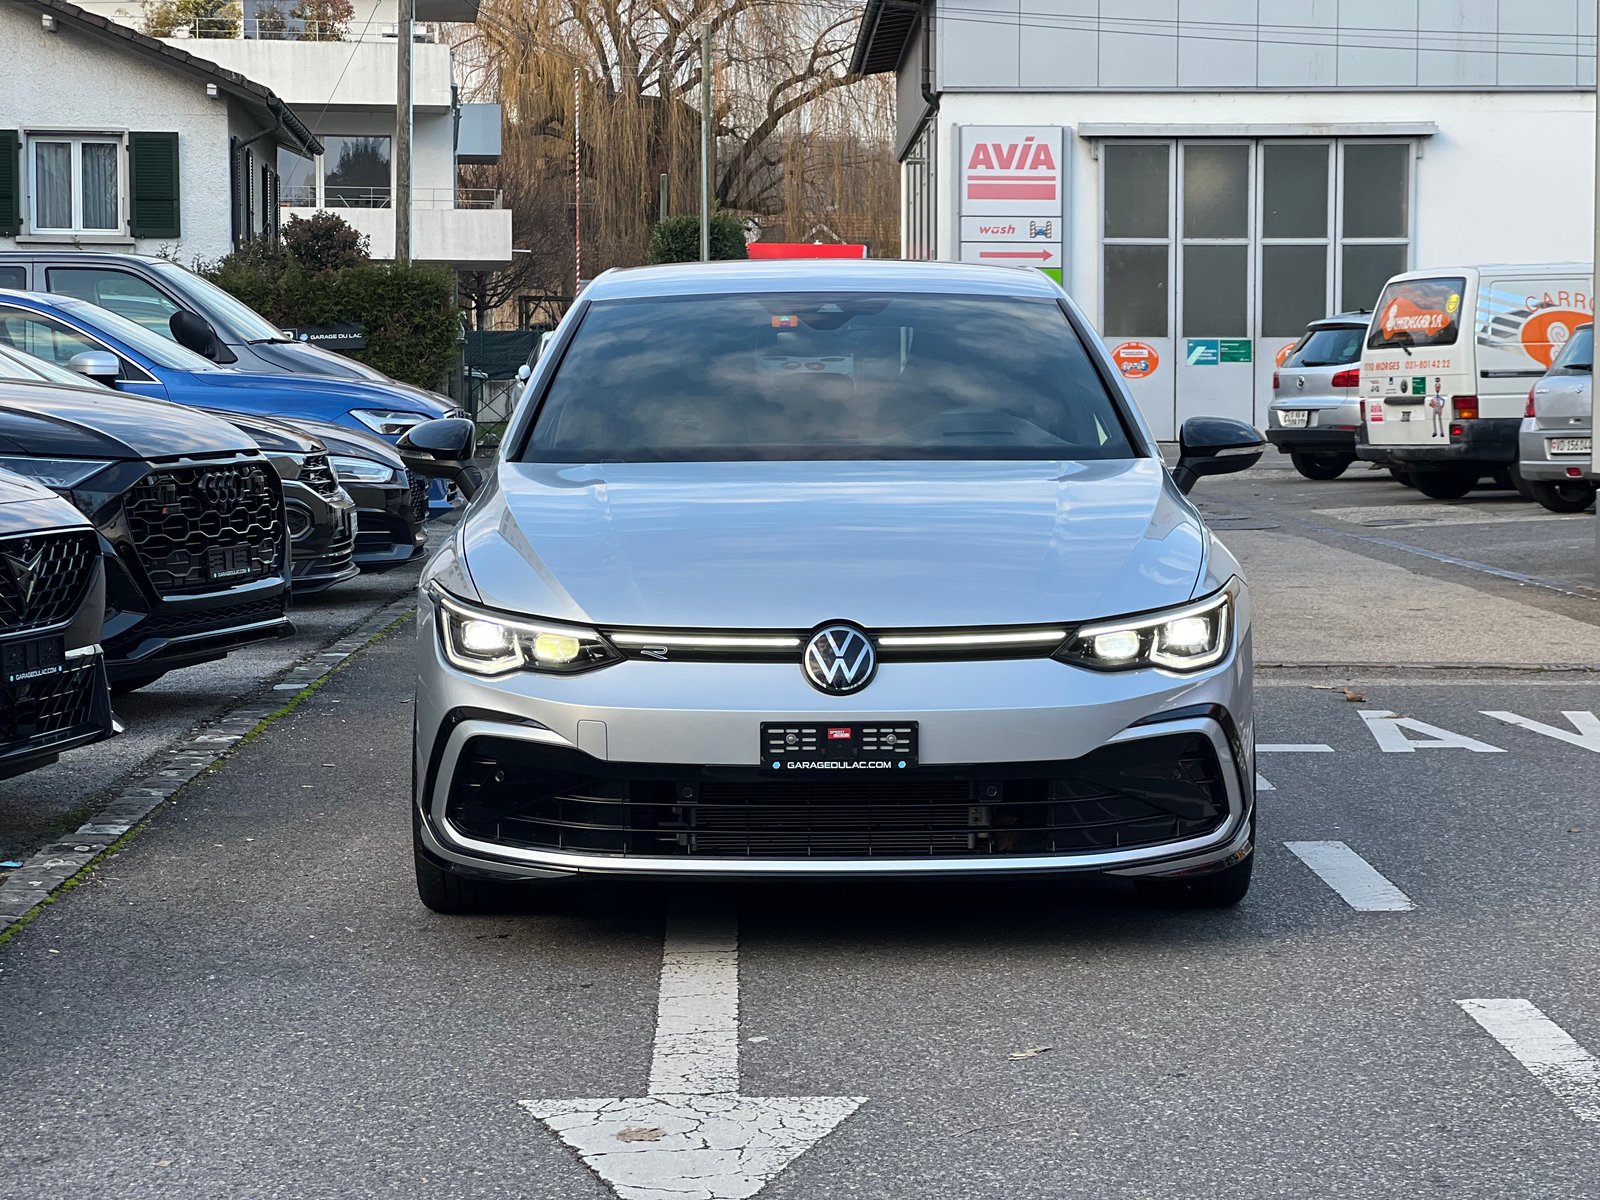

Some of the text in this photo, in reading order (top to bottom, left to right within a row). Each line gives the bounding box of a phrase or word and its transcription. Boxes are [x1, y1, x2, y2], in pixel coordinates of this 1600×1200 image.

[979, 224, 1016, 235] wash
[1375, 362, 1400, 371] MORGES
[787, 761, 892, 769] GARAGEDULAC.COM
